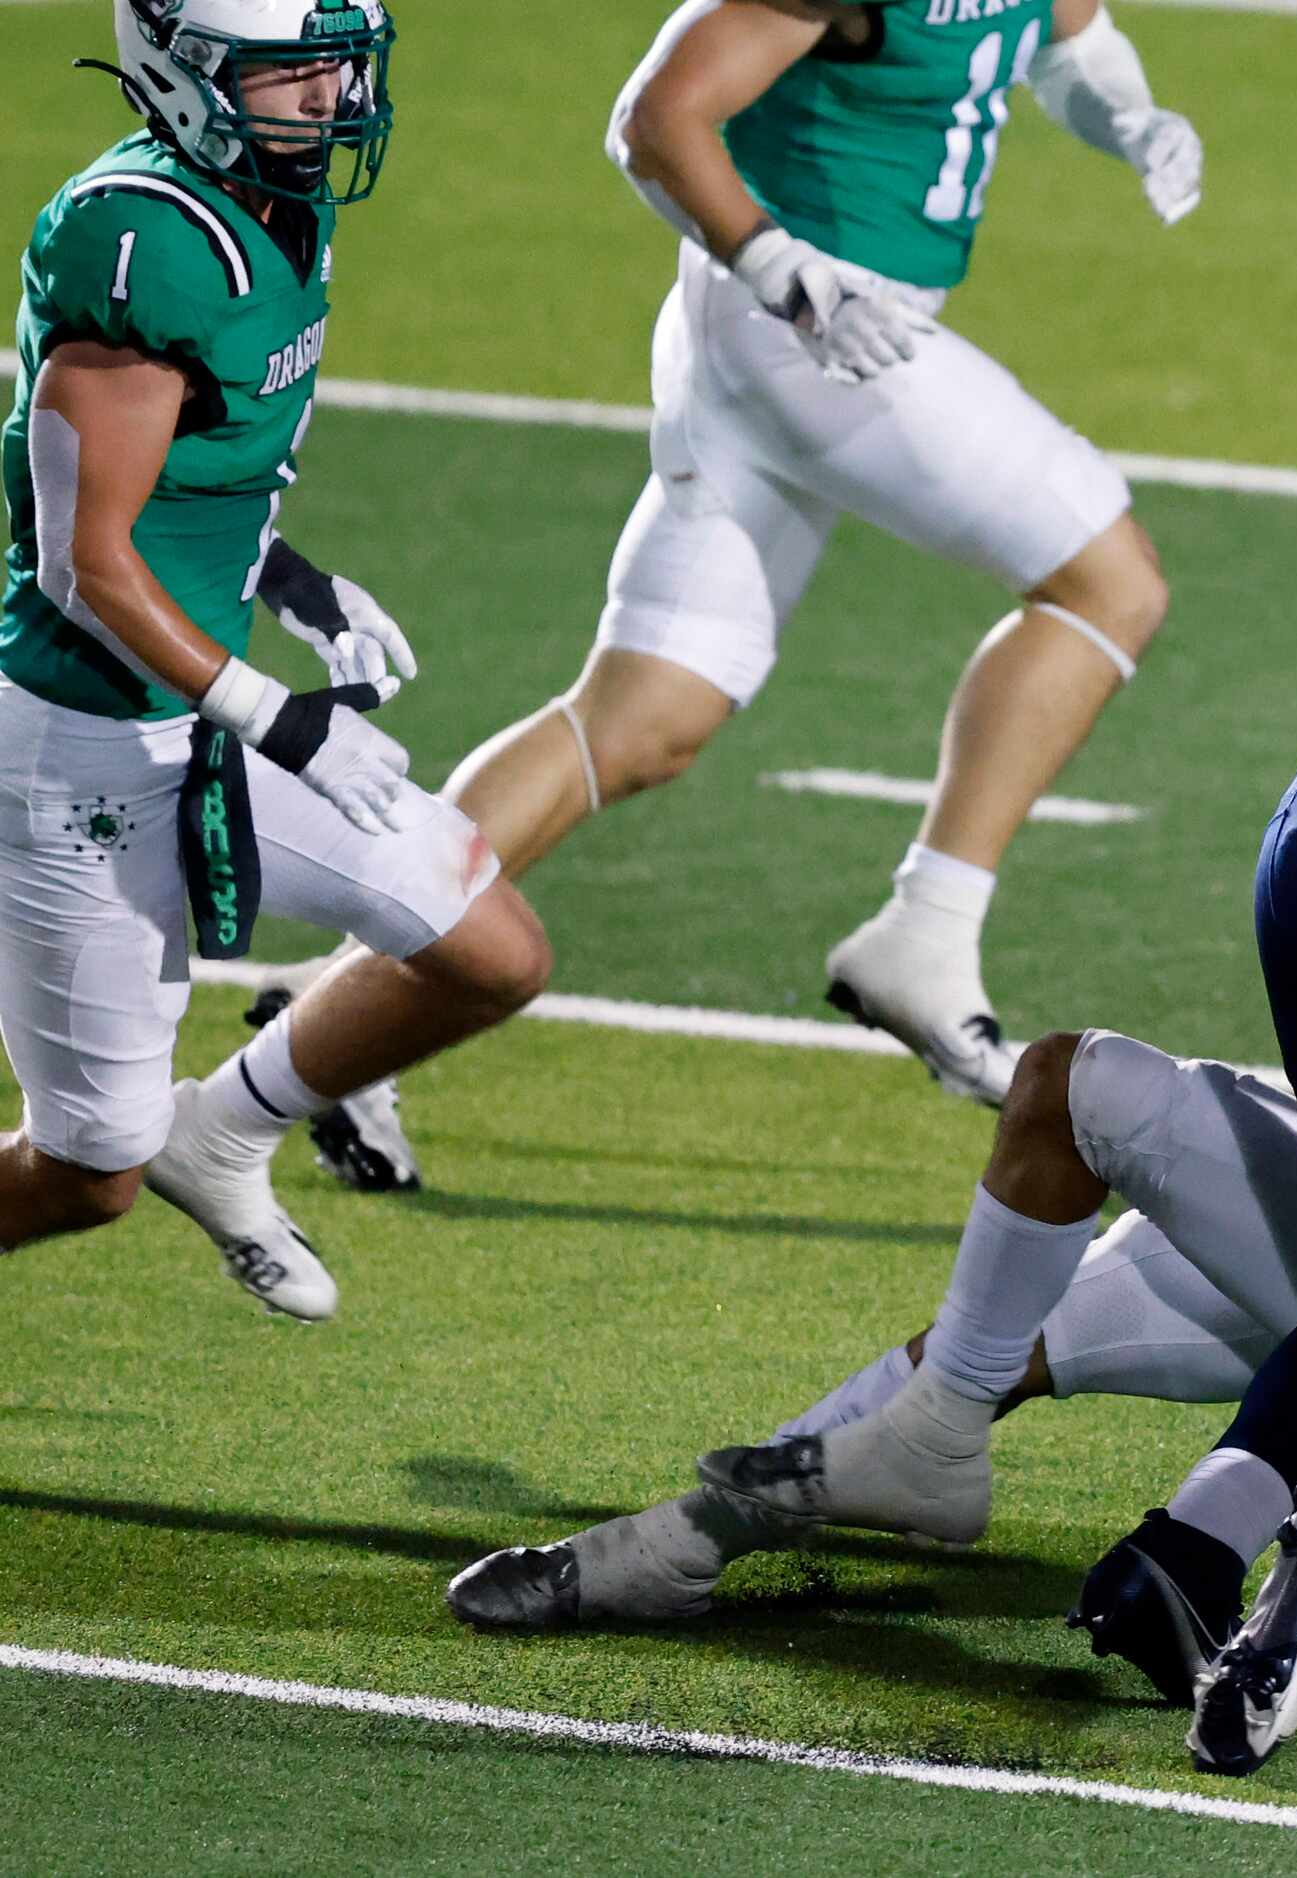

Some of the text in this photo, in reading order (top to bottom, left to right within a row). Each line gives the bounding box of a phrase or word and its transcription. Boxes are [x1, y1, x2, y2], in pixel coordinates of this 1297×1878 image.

[923, 17, 1040, 222] 11
[111, 231, 136, 301] 1
[258, 317, 326, 396] DRAGO
